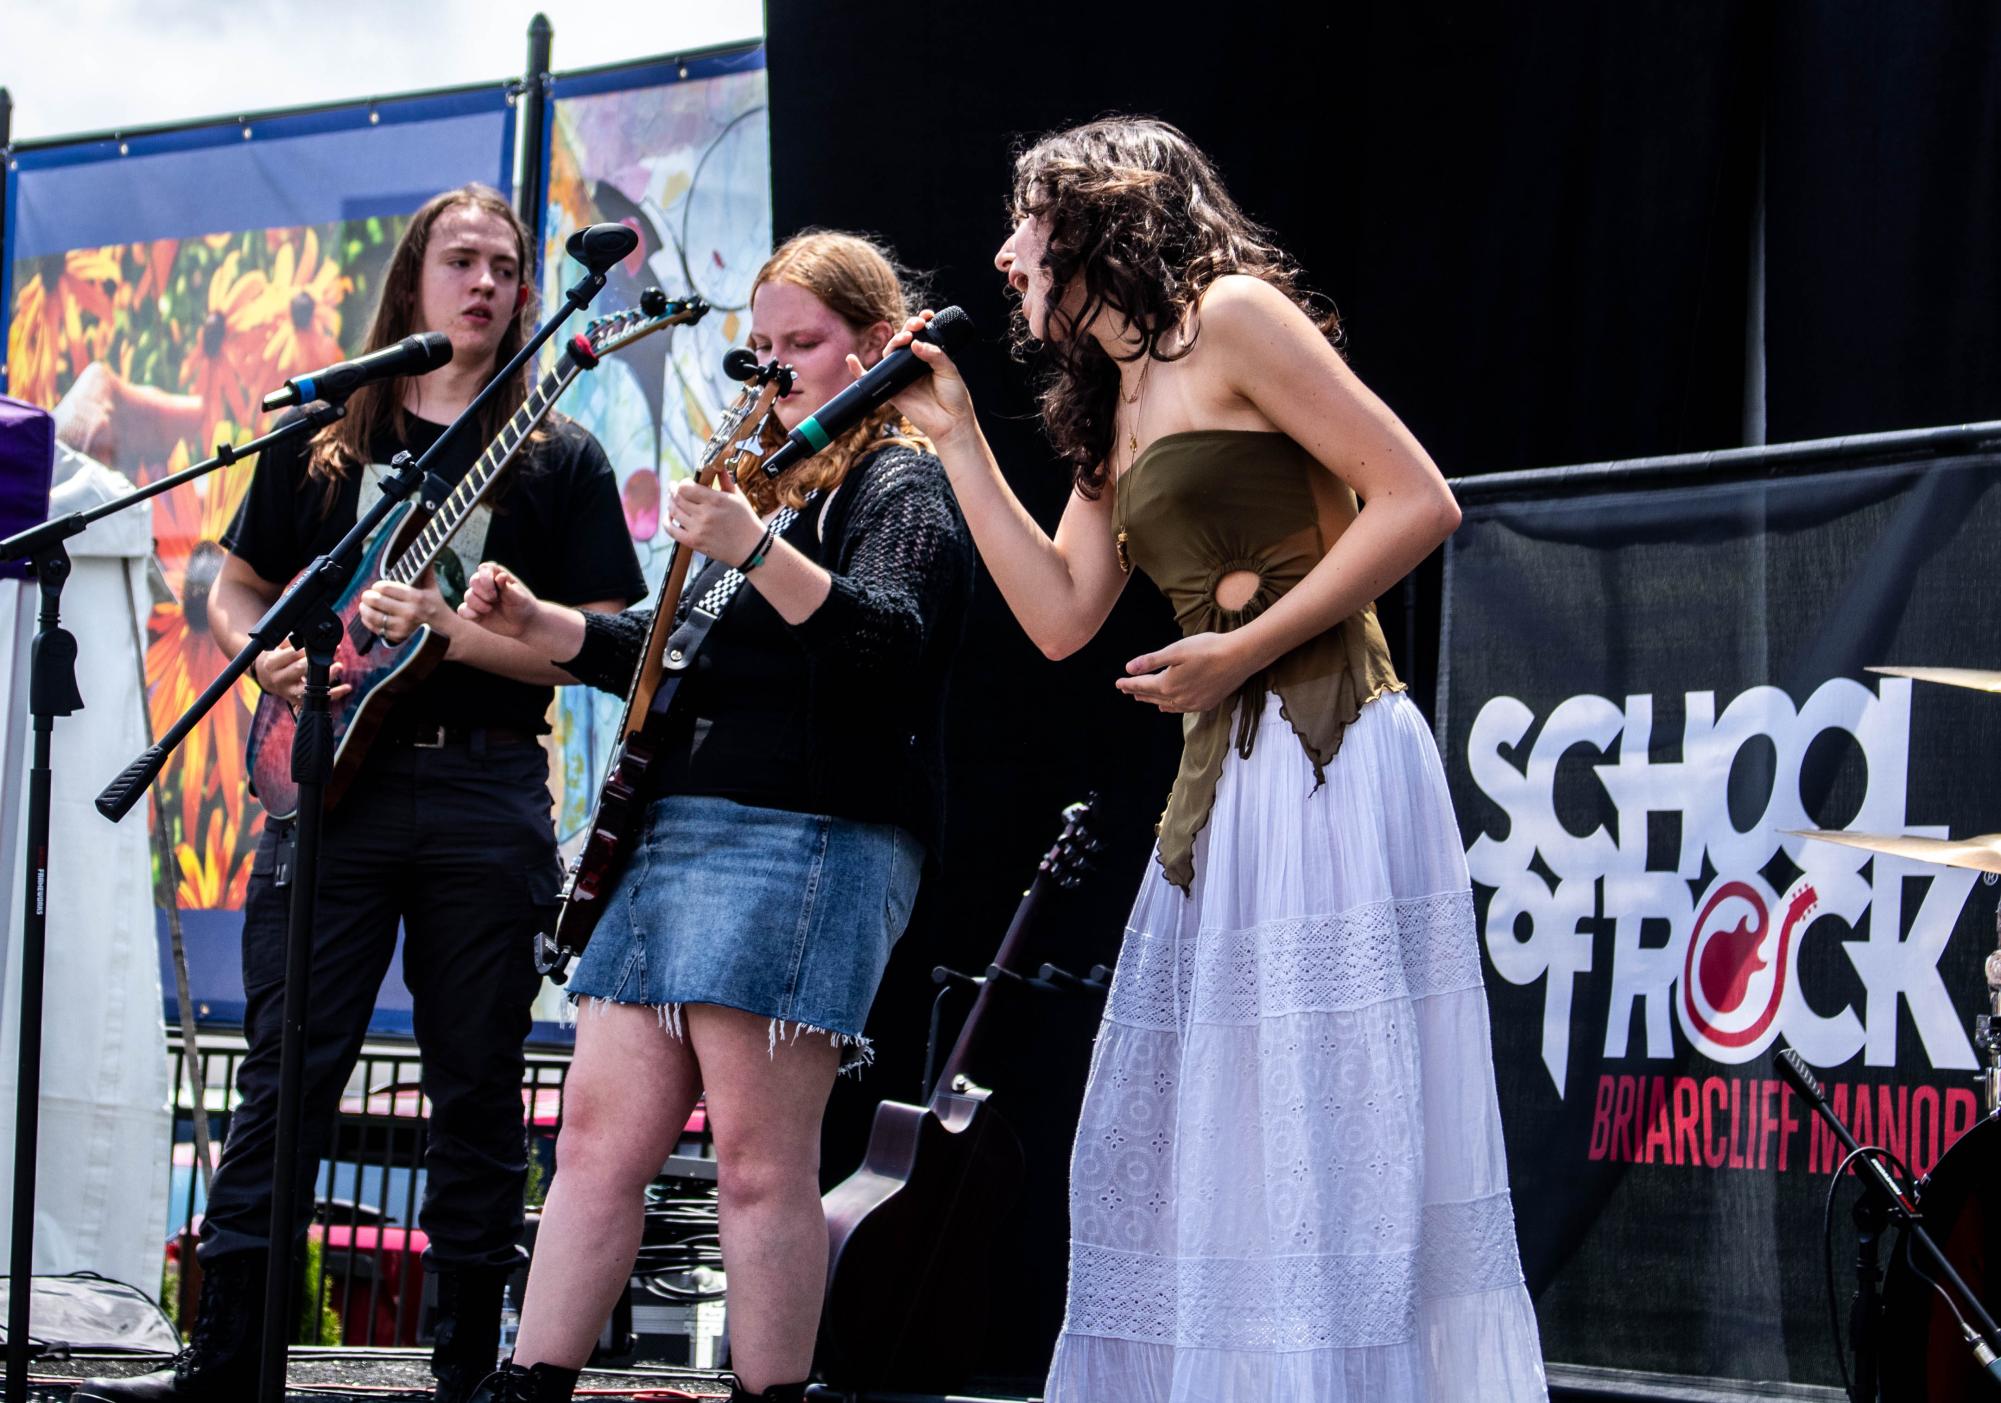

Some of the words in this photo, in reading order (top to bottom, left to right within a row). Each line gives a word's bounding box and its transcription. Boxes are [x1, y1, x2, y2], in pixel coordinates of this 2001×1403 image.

[1467, 677, 1950, 886] SCHOOL
[1603, 871, 1981, 1070] ROCK
[1589, 1074, 1799, 1172] BRIARCLIFF
